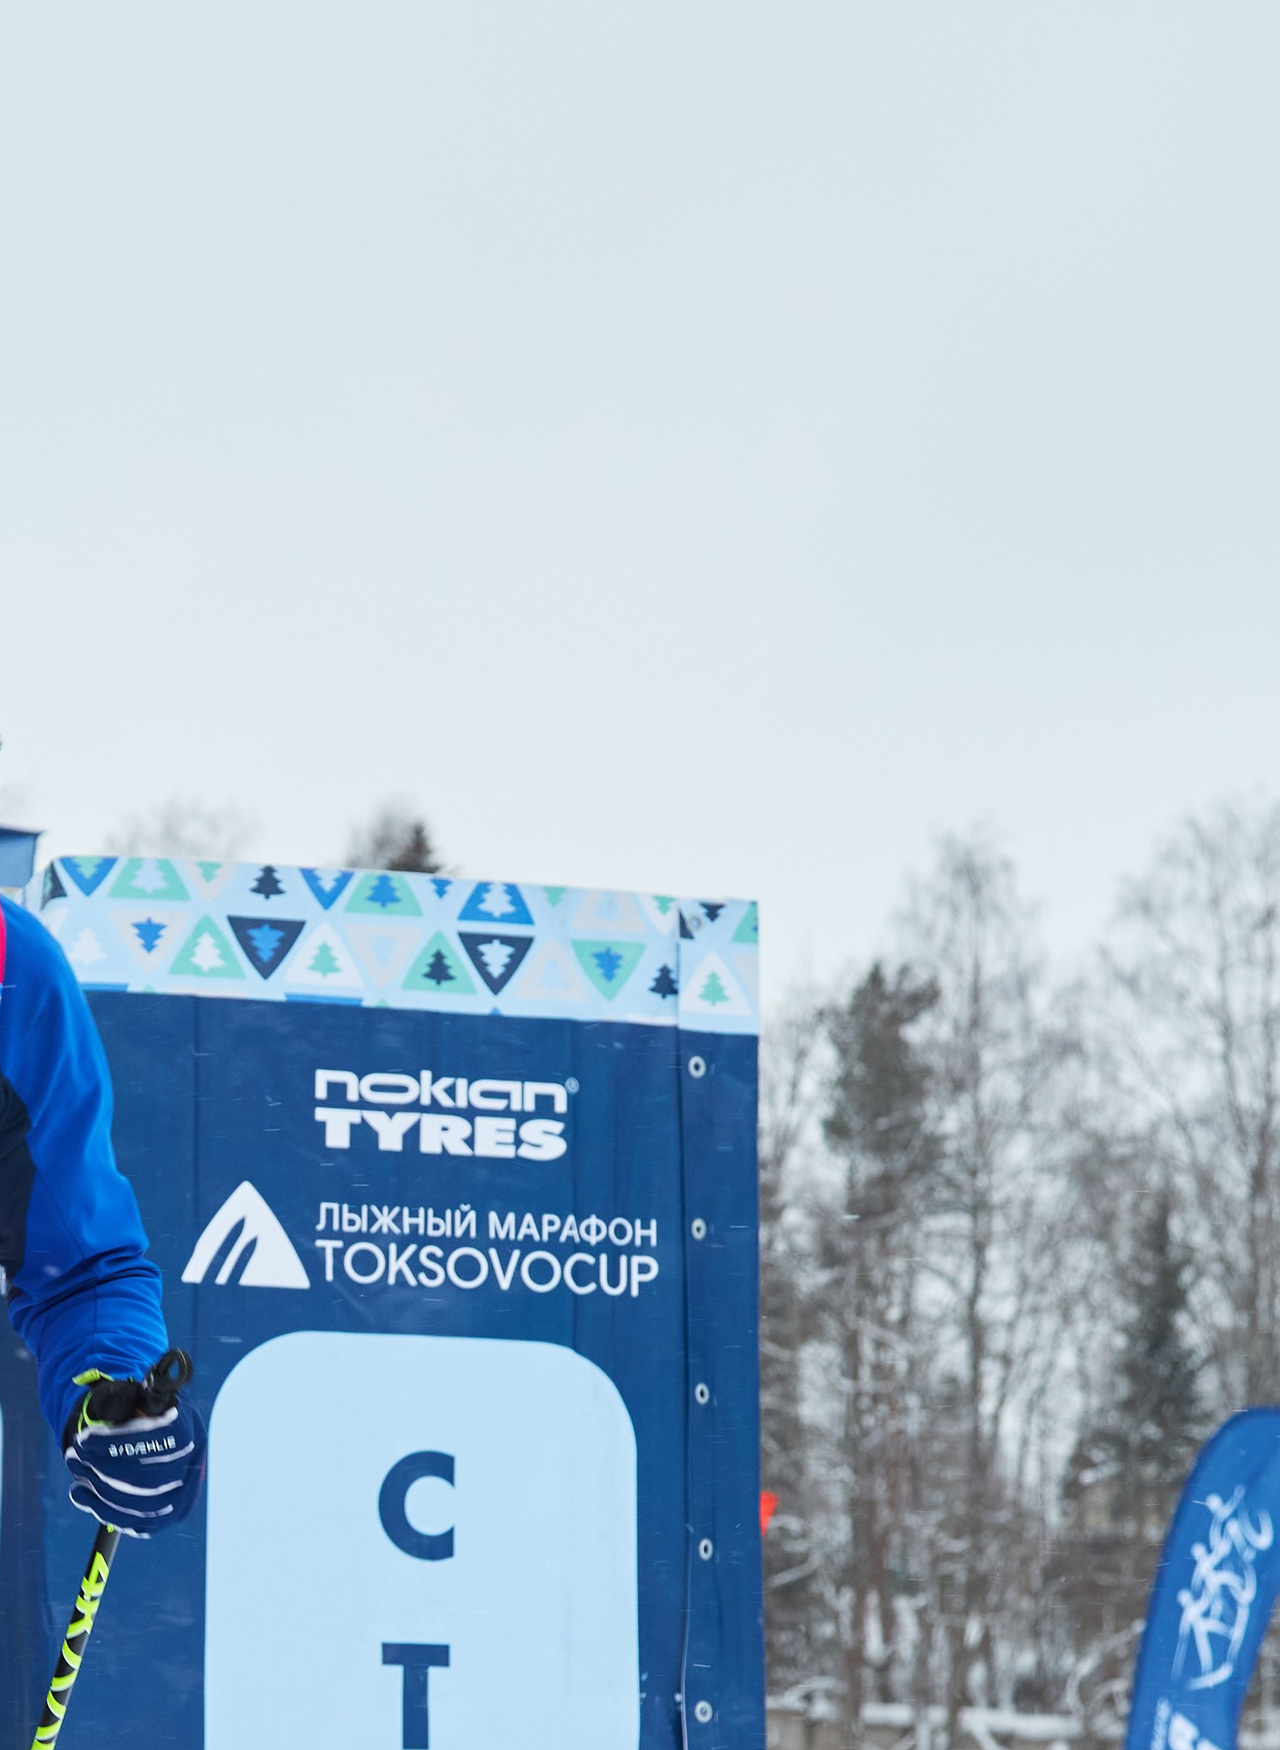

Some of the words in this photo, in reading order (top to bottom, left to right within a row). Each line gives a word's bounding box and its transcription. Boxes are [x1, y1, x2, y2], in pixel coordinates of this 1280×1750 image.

[314, 1106, 568, 1161] TYRES
[315, 1202, 477, 1239] ЛЫЖНЫЙ
[488, 1210, 658, 1248] МАРАФОН
[315, 1239, 659, 1297] TOKSOVOCUP
